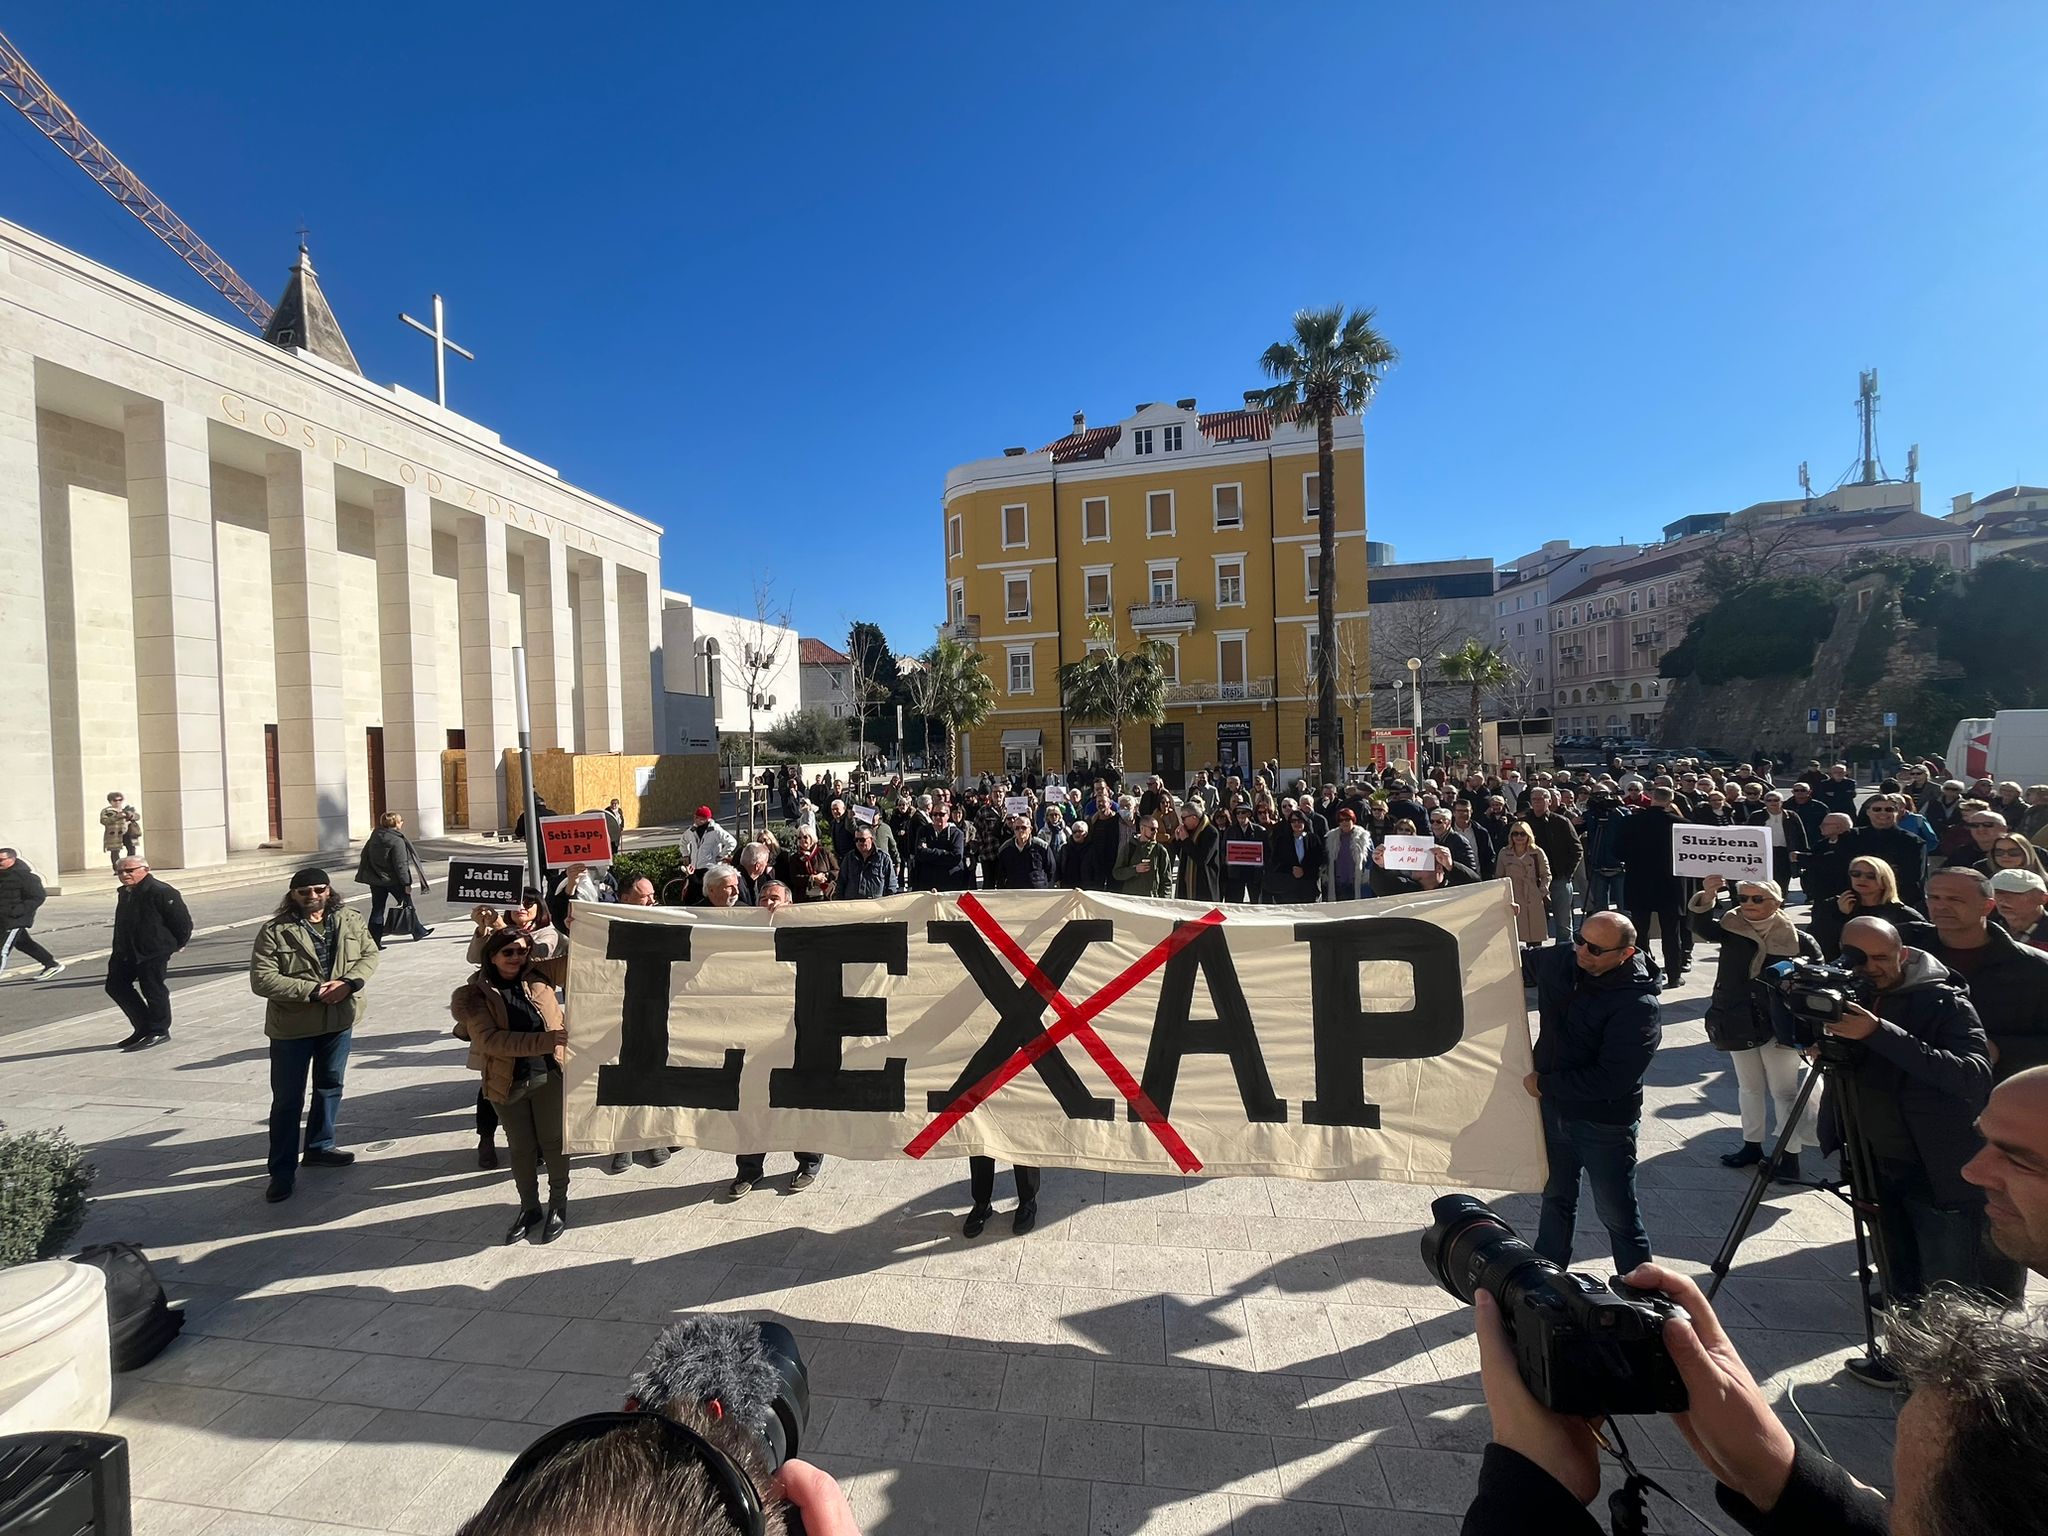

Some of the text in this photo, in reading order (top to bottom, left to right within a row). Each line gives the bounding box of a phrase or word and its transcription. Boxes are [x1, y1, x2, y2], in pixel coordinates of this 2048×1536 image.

[220, 392, 367, 469] GOSPI
[399, 463, 442, 494] OD
[547, 830, 572, 840] Sebi
[1681, 835, 1759, 848] Službena
[1390, 844, 1405, 852] Sebi
[1678, 852, 1763, 865] poopćenja
[464, 868, 509, 881] Jadni
[458, 885, 513, 899] interes
